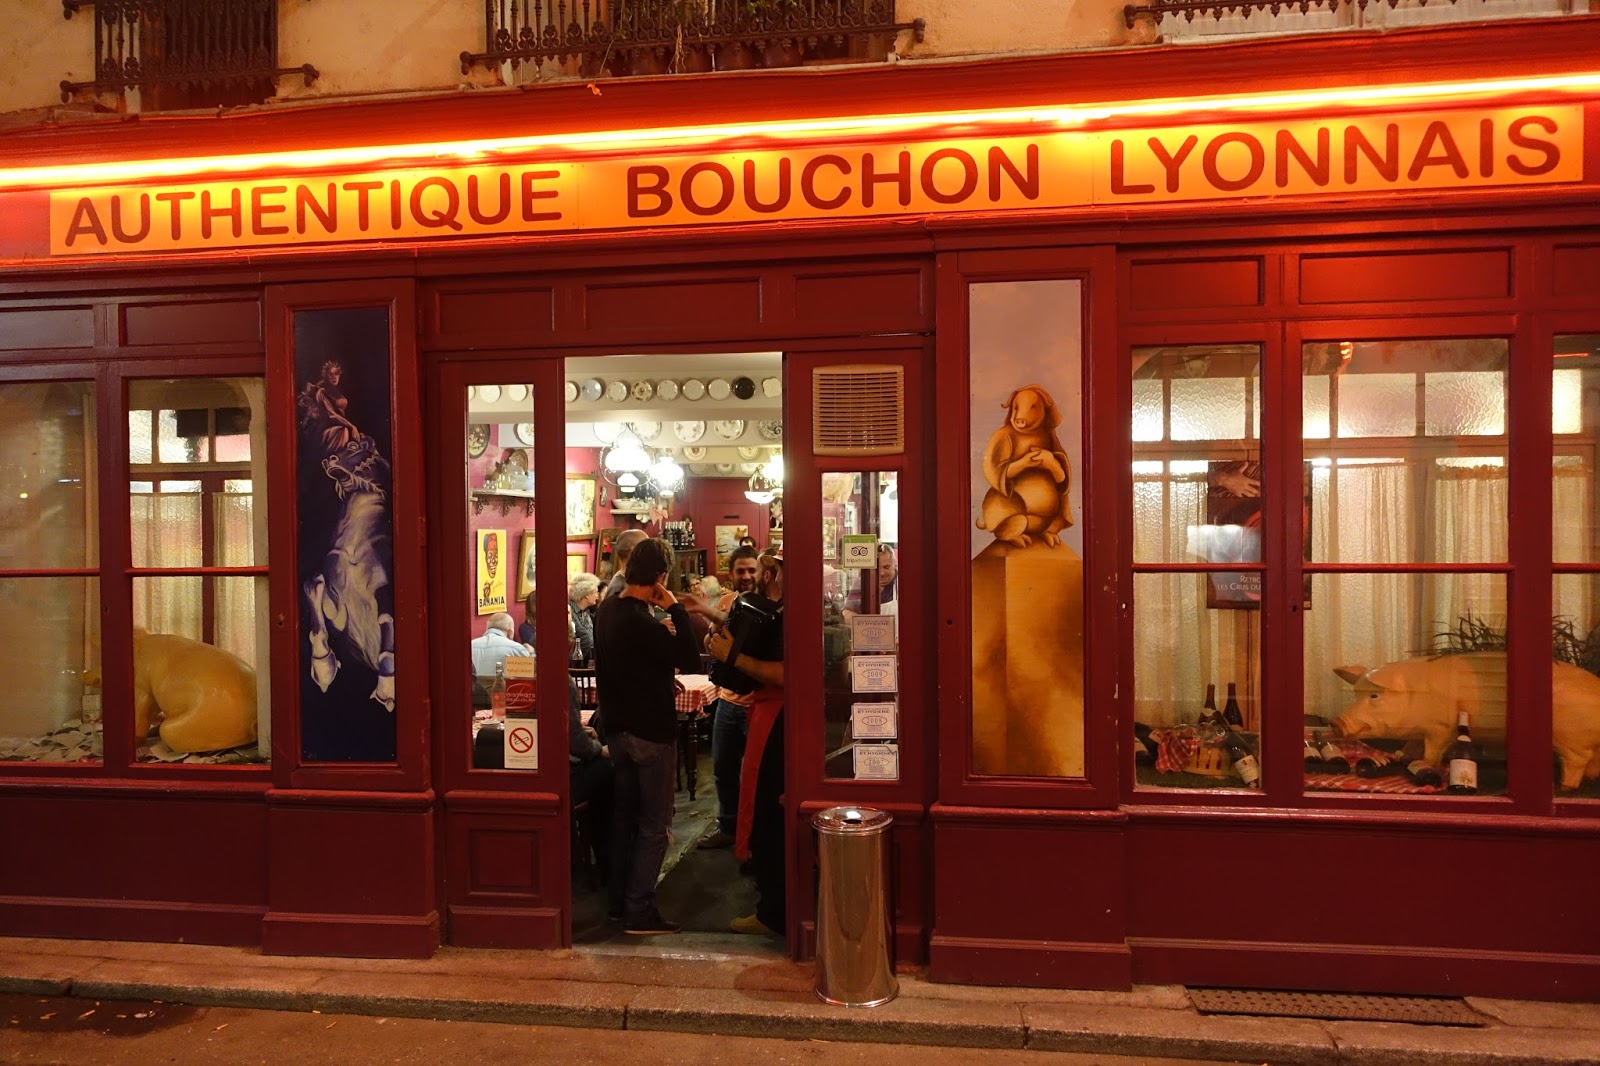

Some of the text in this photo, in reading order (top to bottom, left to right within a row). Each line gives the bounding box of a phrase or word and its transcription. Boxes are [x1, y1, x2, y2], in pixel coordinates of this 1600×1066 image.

[65, 115, 1561, 247] AUTHENTIQUE BOUCHON LYONNAIS
[479, 596, 506, 608] BANANIA
